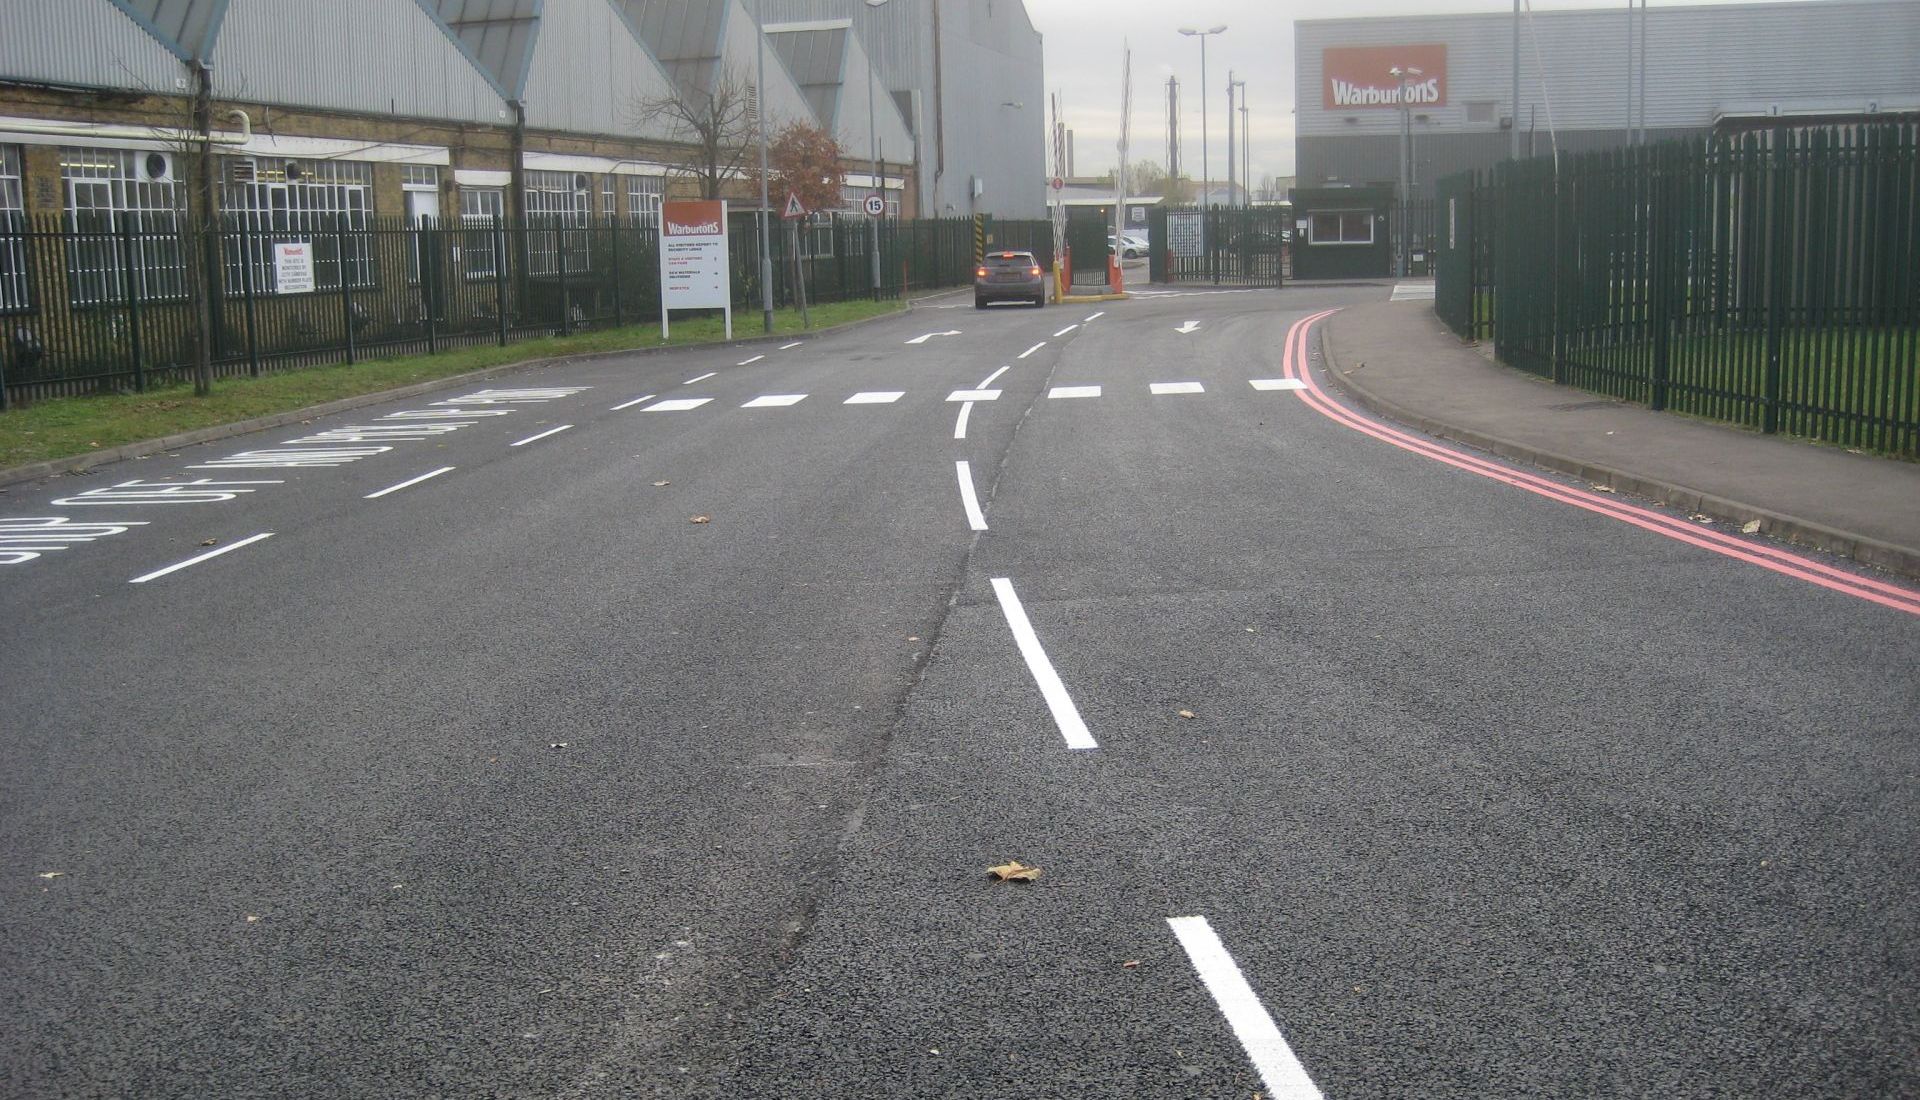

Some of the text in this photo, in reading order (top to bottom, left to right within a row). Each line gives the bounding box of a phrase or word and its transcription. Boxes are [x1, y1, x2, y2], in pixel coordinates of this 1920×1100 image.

[1771, 105, 1777, 115] 1
[1869, 102, 1877, 112] 2
[869, 200, 881, 211] 15
[667, 221, 719, 235] Warburtons
[372, 409, 517, 420] UP
[280, 420, 479, 444] PICK
[185, 446, 394, 468] AND
[51, 479, 285, 505] OFF
